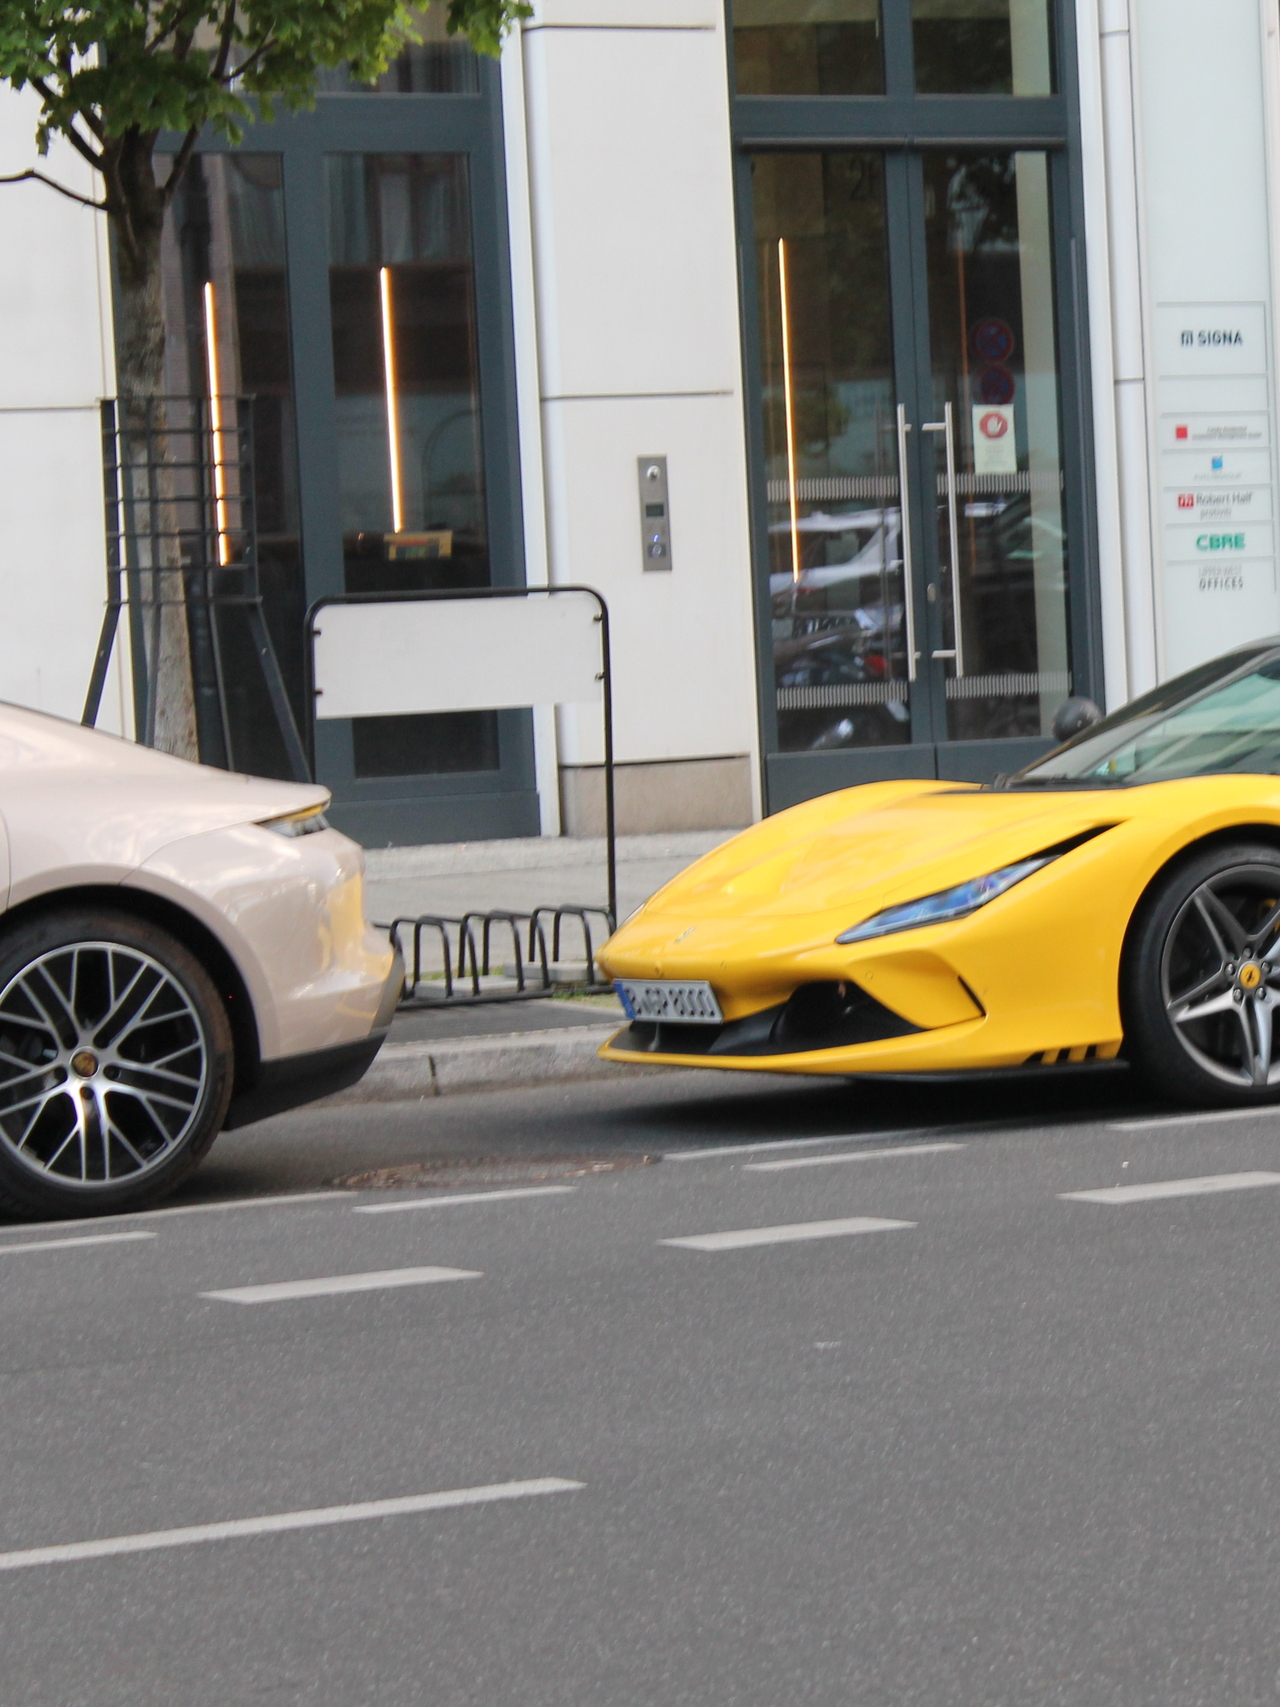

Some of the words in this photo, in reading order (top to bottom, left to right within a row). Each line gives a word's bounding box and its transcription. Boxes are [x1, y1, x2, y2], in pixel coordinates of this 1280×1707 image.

[1198, 330, 1243, 346] SIGNA
[1196, 493, 1230, 506] Robert
[1232, 490, 1252, 505] Half
[1196, 533, 1245, 550] CBRE
[1199, 577, 1243, 590] OFFICES
